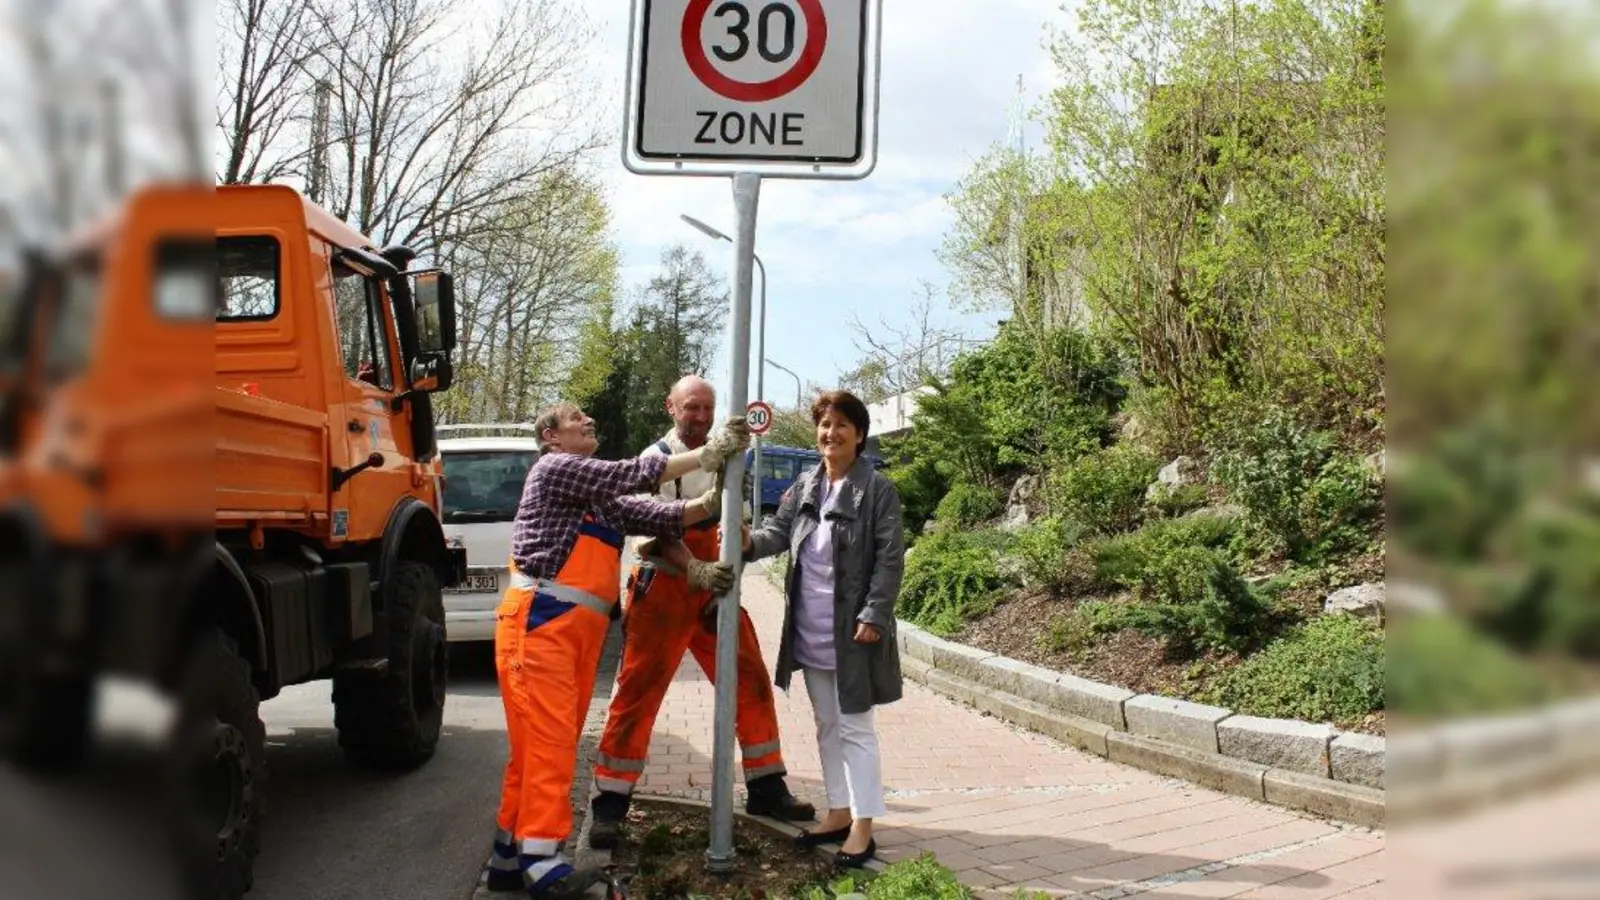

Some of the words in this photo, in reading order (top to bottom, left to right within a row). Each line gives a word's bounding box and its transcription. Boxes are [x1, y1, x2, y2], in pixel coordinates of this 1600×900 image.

[712, 2, 795, 63] 30
[694, 111, 804, 145] ZONE
[749, 410, 766, 425] 30
